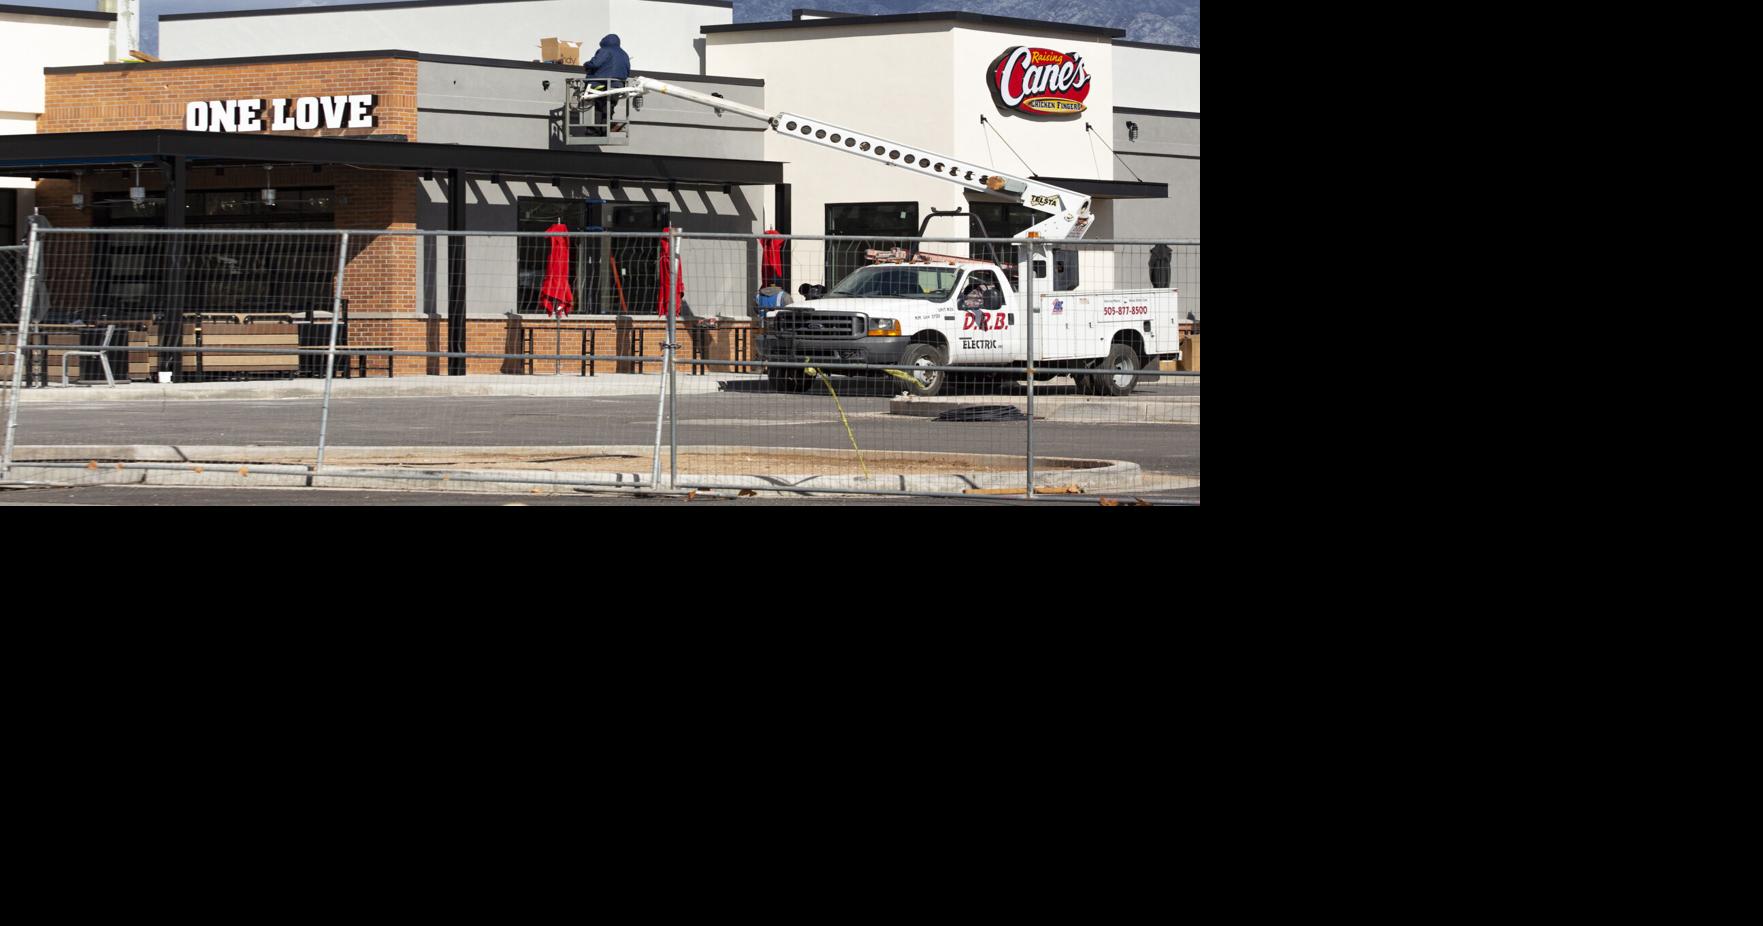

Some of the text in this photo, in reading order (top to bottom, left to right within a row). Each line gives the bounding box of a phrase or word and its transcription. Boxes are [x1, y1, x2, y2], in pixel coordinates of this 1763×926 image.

[1032, 51, 1063, 64] Raising
[1001, 46, 1091, 106] Cane's
[1031, 99, 1056, 109] CHICKEN
[186, 94, 373, 133] ONE LOVE
[1031, 194, 1057, 207] TELSTA
[1103, 305, 1148, 316] 505-877-8500
[962, 312, 1009, 331] D.R.B.
[962, 339, 997, 350] ELECTRIC
